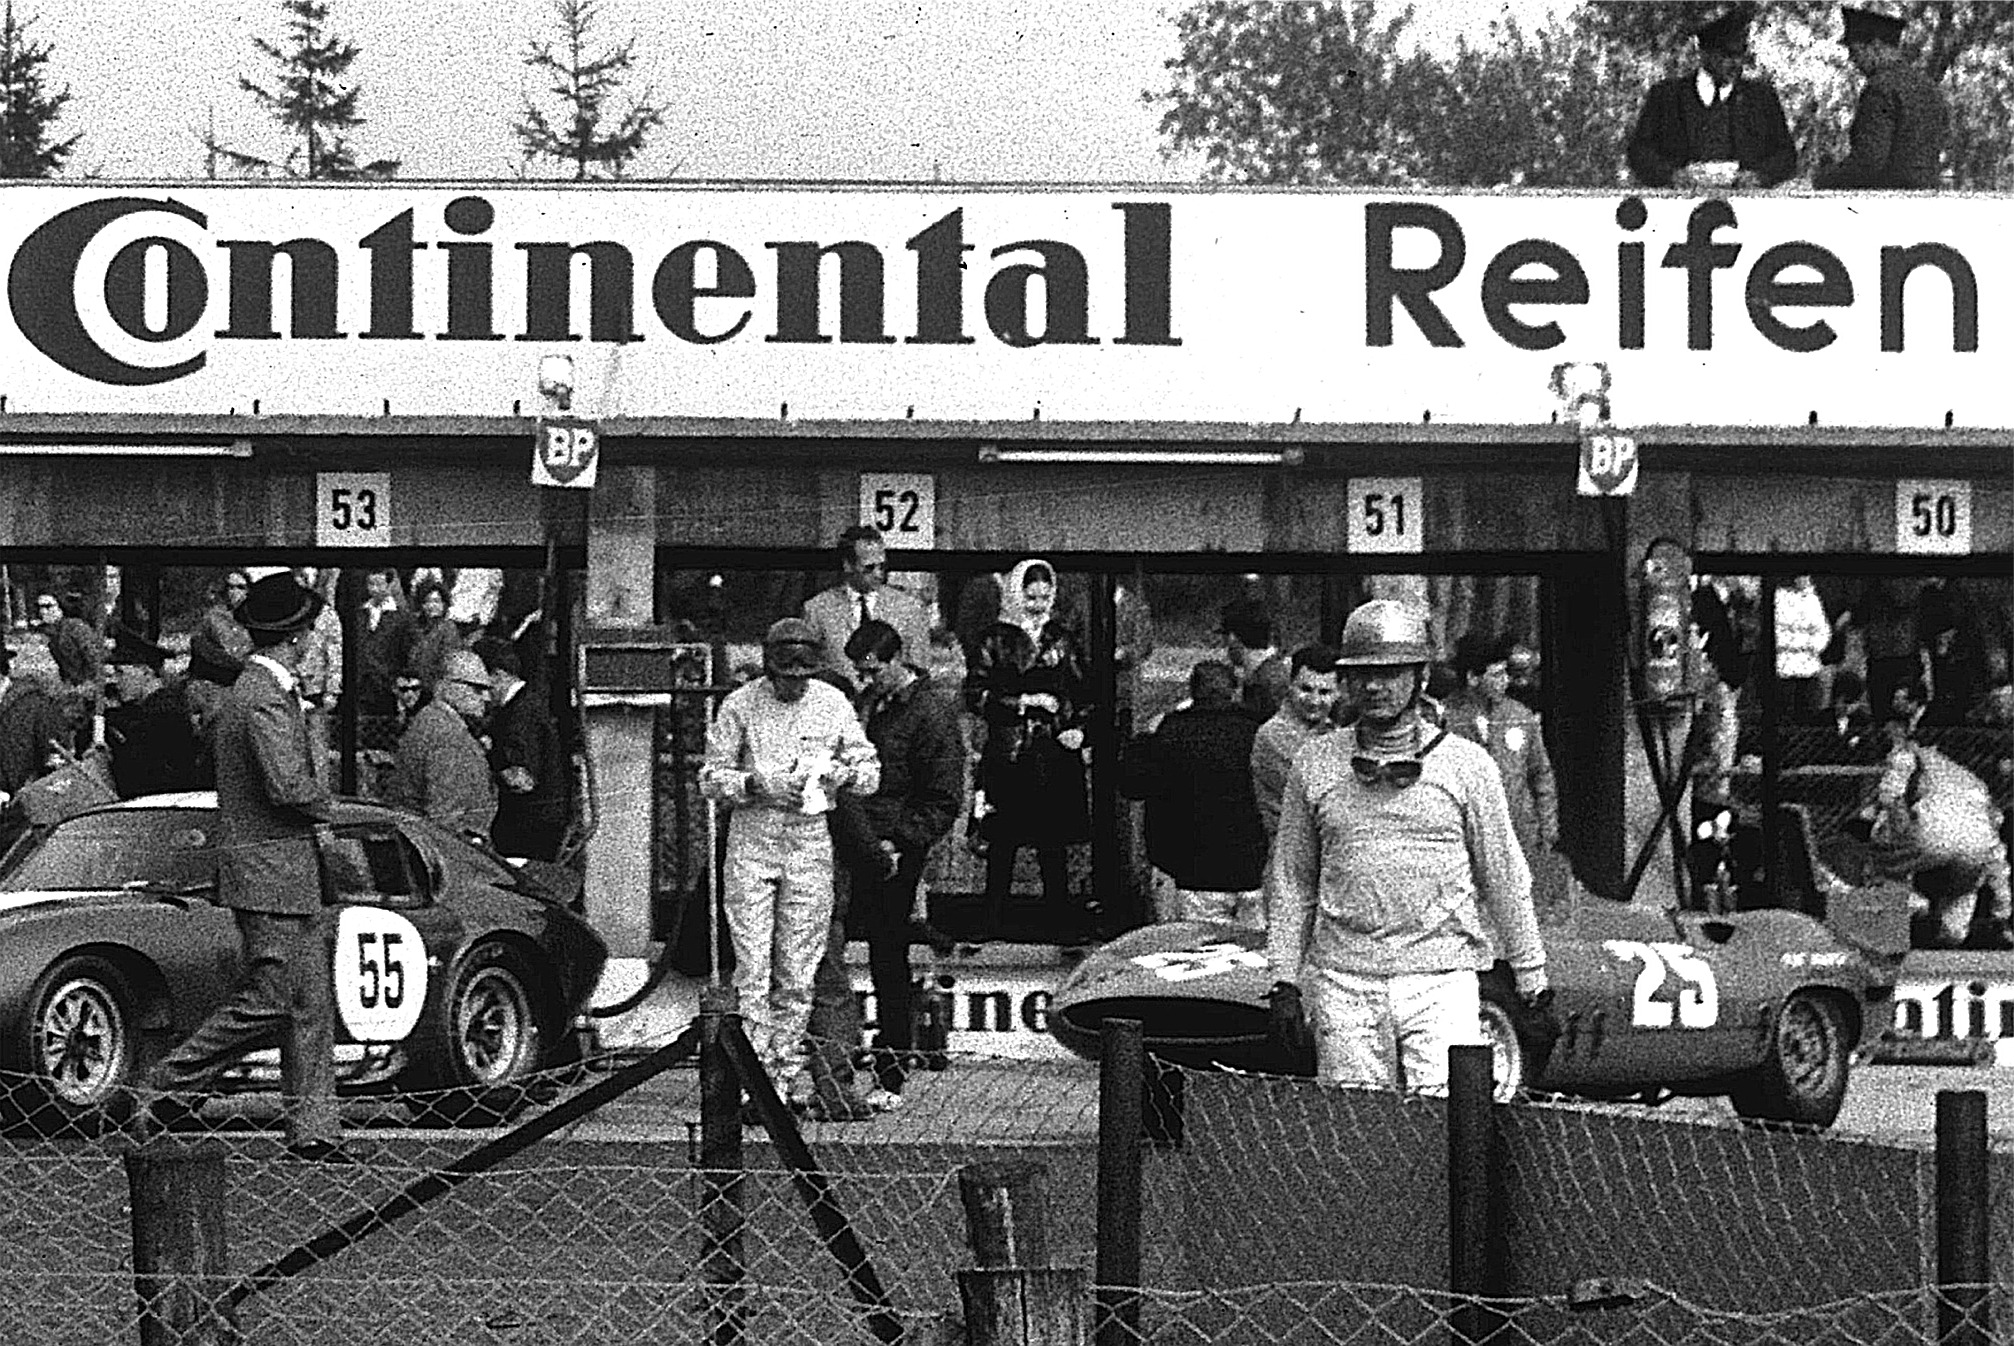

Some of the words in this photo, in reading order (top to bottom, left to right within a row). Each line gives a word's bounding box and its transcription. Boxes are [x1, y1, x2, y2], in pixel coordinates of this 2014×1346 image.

[7, 196, 1182, 386] Continental
[1365, 196, 1978, 353] Reifen
[548, 426, 595, 467] BP
[1591, 435, 1636, 475] BP
[331, 488, 376, 531] 53
[876, 490, 919, 532] 52
[1365, 494, 1404, 536] 51
[1913, 494, 1955, 537] 50
[357, 932, 404, 1009] 55
[1601, 939, 1719, 1029] 25
